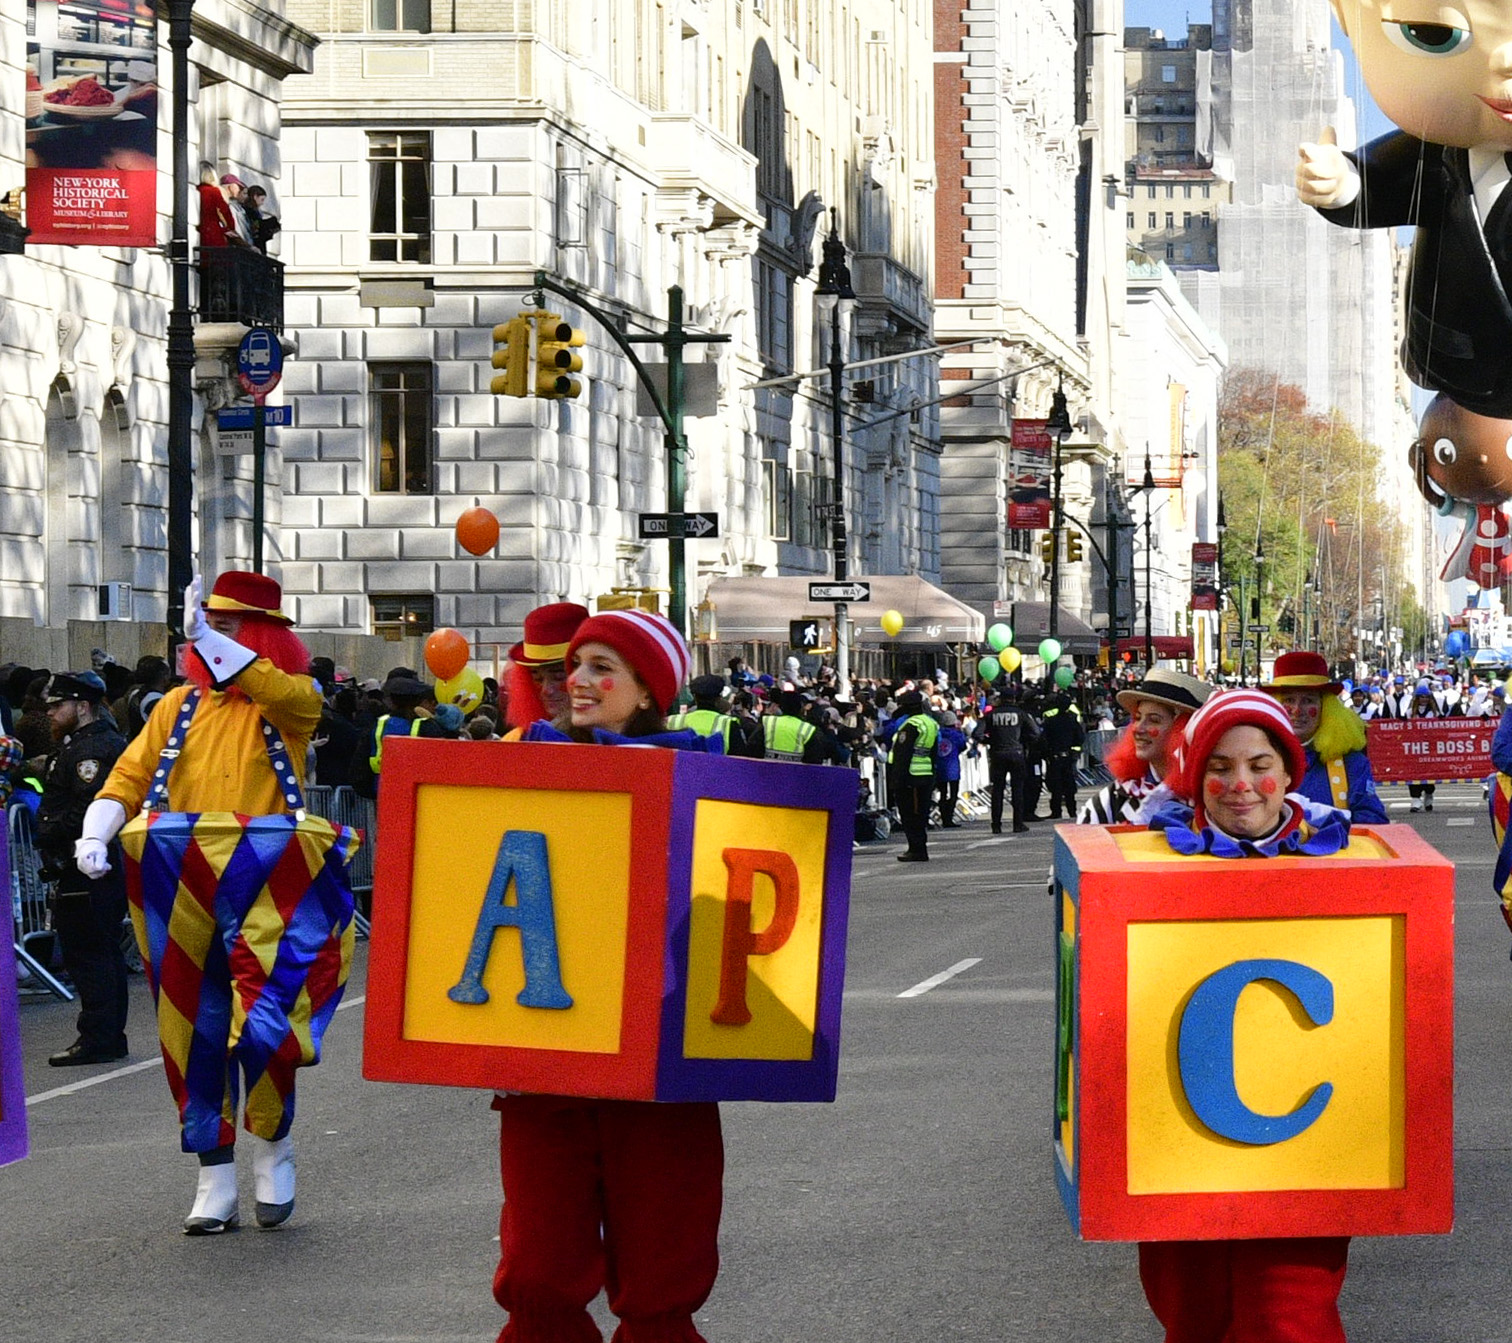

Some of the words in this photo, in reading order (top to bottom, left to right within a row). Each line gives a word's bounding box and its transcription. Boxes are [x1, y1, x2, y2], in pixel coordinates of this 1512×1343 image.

[53, 176, 121, 188] NEW-YORK
[53, 187, 129, 199] HISTORICAL
[52, 197, 105, 209] SOCIETY
[53, 209, 87, 217] MUSEUM
[96, 210, 128, 218] LIBRARY
[650, 520, 667, 531] ON
[813, 587, 832, 596] ONE
[842, 587, 862, 596] WAY
[992, 712, 1019, 726] NYPD
[1416, 719, 1481, 730] THANKSGIVING
[1402, 741, 1430, 755] THE
[1436, 740, 1475, 755] BOSS
[447, 830, 574, 1010] A
[710, 847, 800, 1026] P
[1176, 958, 1335, 1145] C
